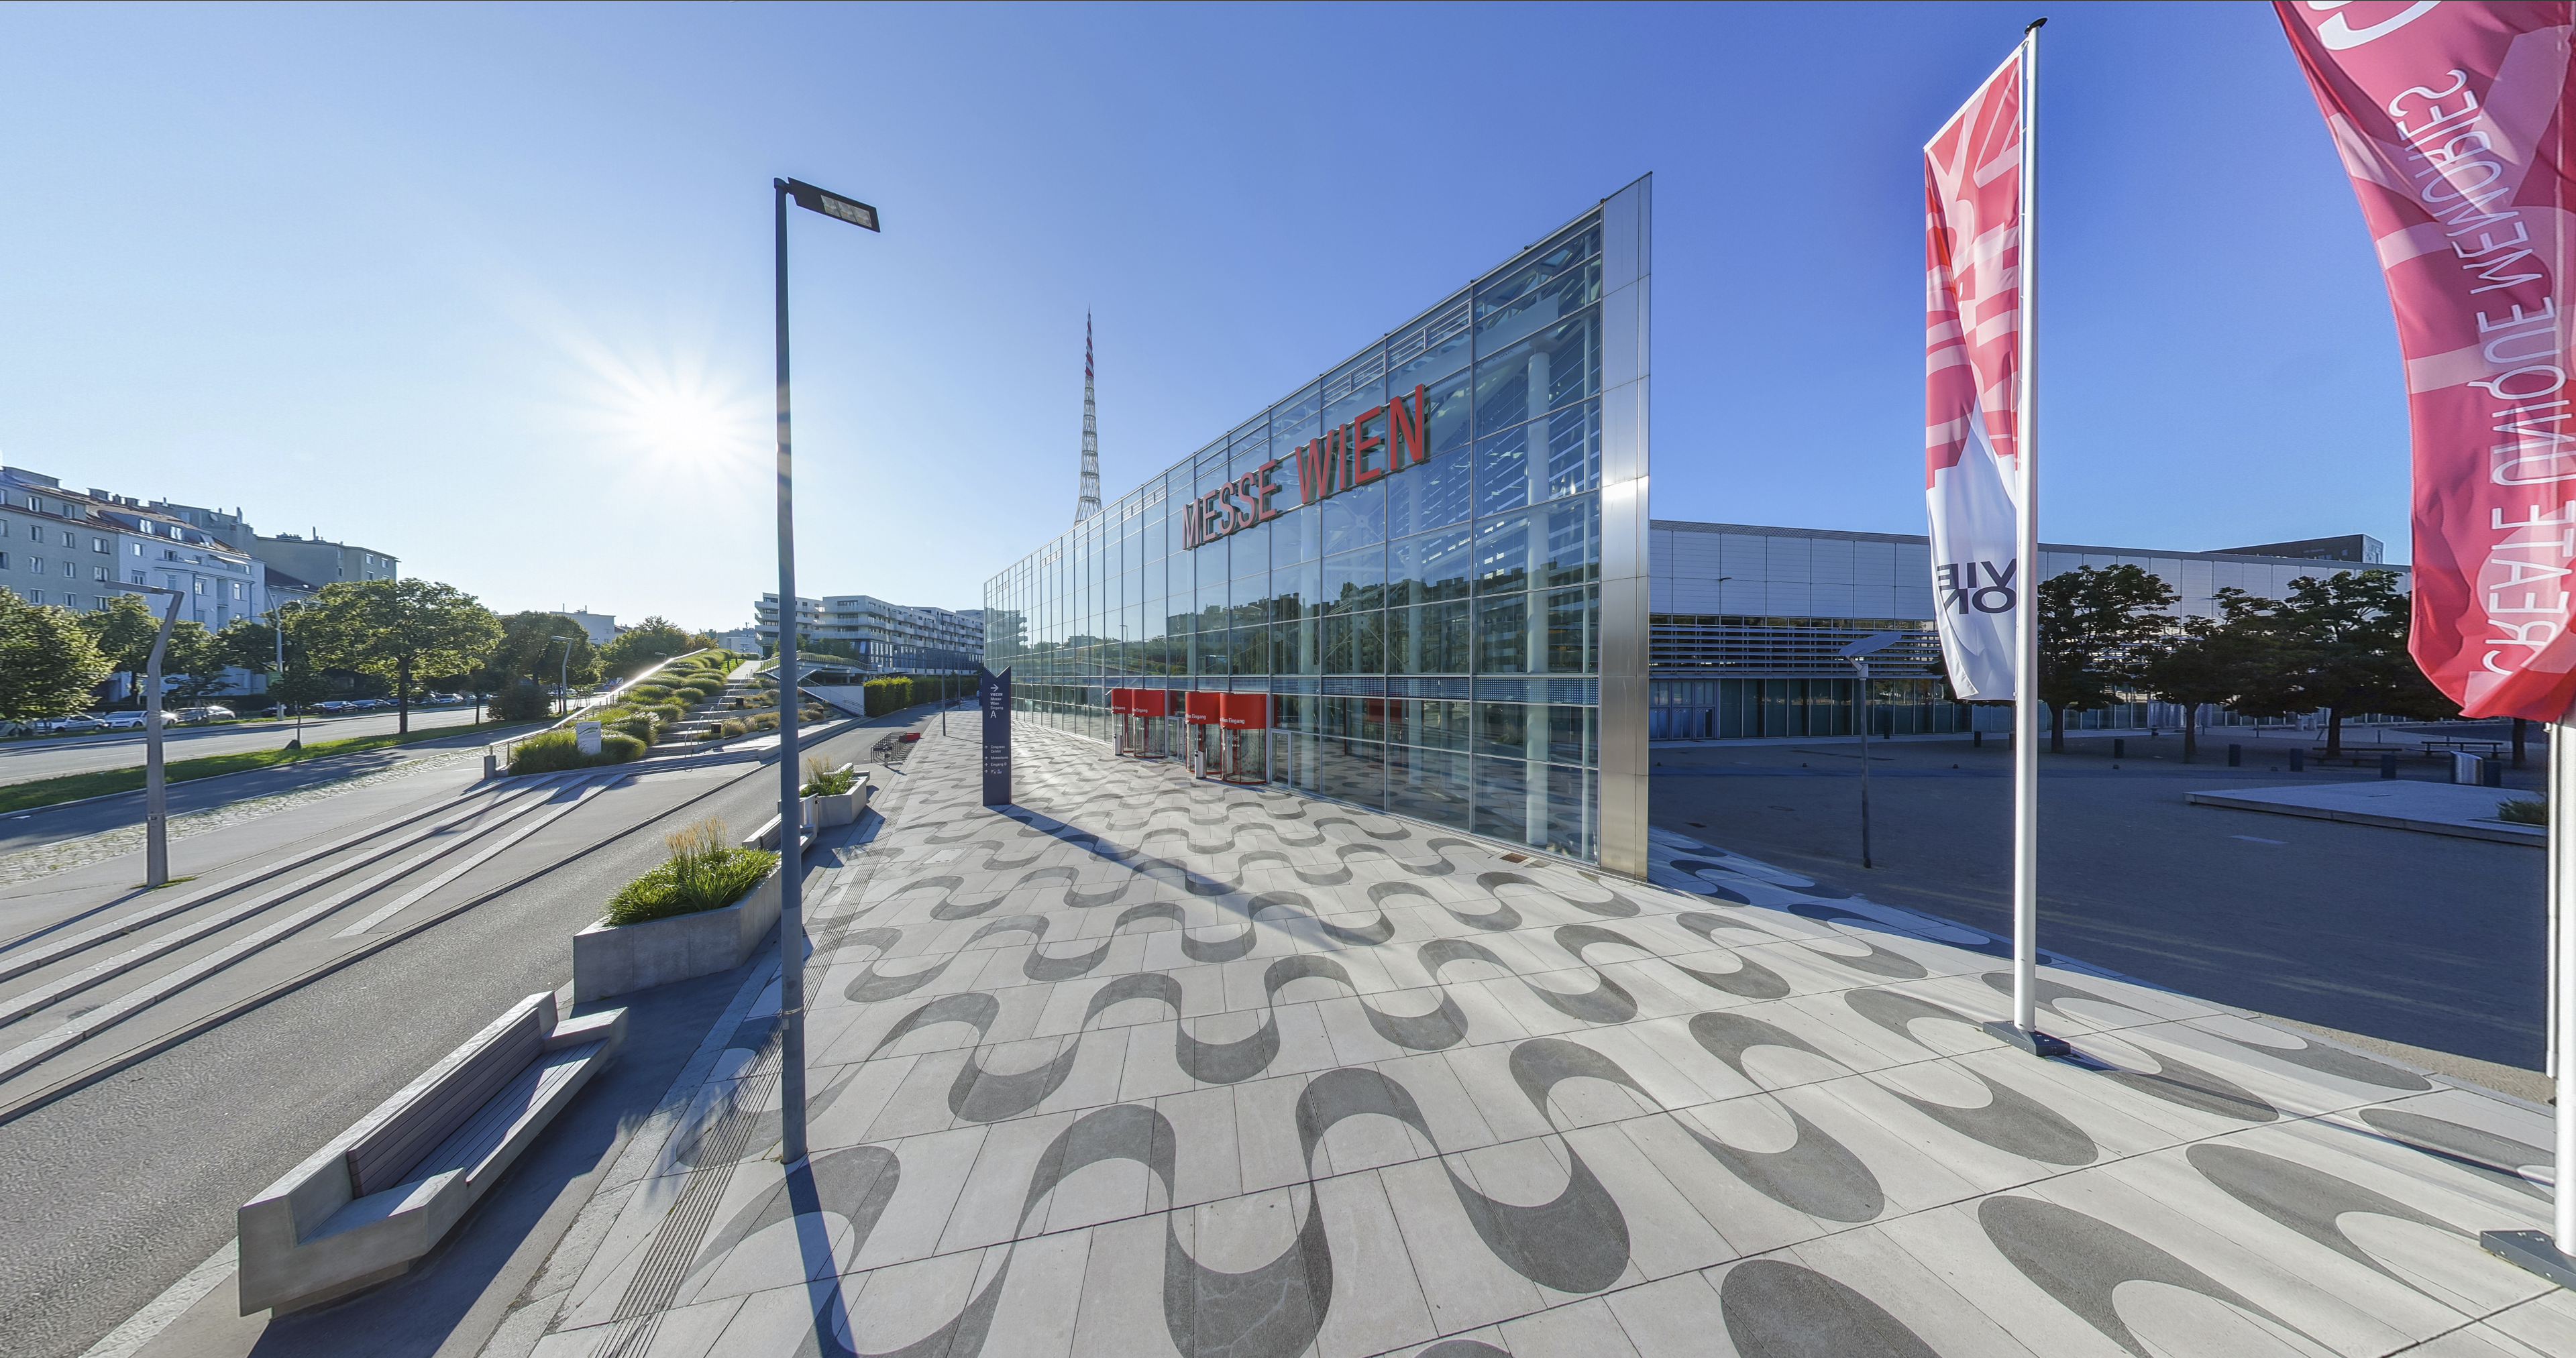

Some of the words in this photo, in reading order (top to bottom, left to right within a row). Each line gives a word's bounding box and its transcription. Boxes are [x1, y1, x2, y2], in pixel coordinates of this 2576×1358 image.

[1182, 458, 1277, 550] MESSE
[1295, 383, 1426, 504] WIEN
[990, 710, 997, 718] A
